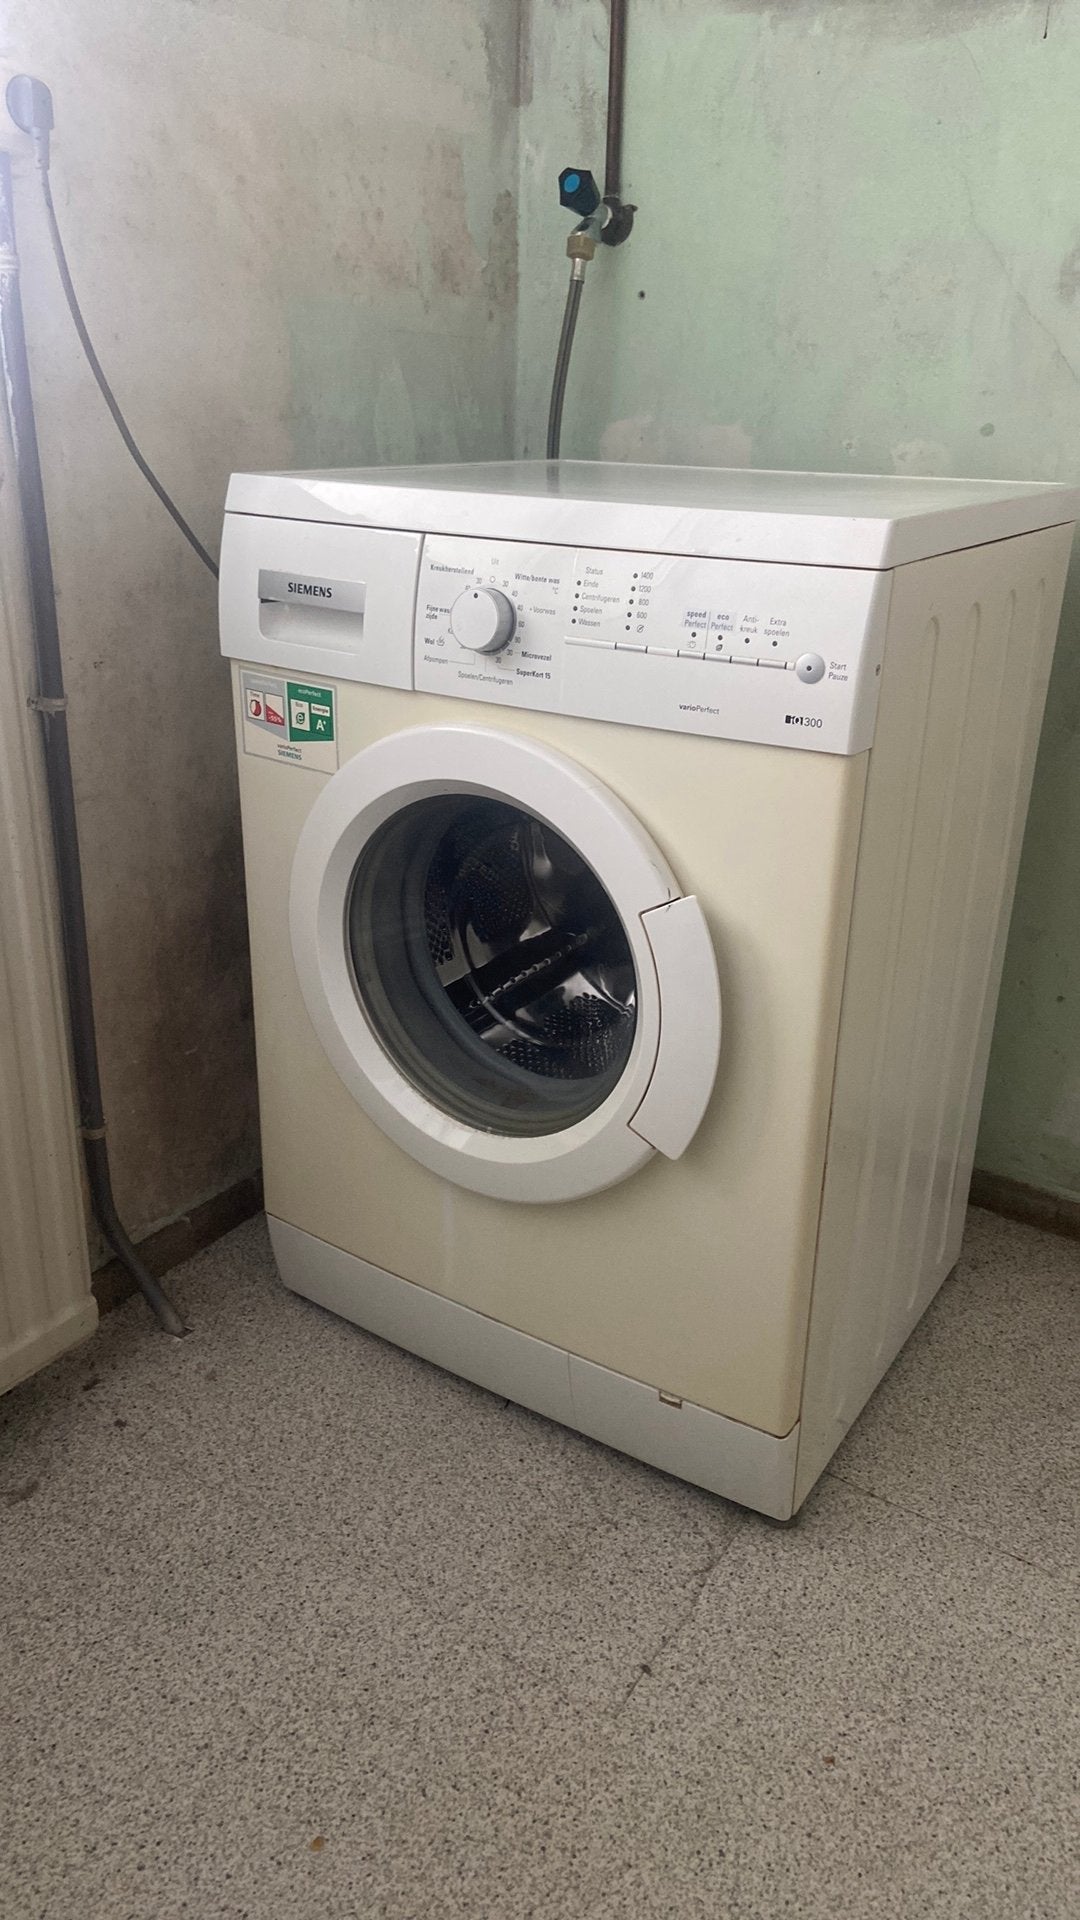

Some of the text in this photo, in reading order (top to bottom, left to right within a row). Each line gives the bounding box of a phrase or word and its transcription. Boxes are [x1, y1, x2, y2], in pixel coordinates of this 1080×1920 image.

[585, 566, 604, 576] Status
[641, 572, 654, 580] 1400
[584, 580, 598, 588] Einde
[288, 582, 332, 598] SIEMENS
[639, 585, 652, 593] 1200
[582, 592, 620, 604] Centrifugeren
[638, 598, 650, 606] 800
[580, 606, 602, 615] Spoelen
[686, 610, 707, 618] speed
[636, 612, 648, 620] 600
[743, 615, 760, 623] Anti-
[578, 618, 600, 628] Wassen
[684, 620, 706, 628] Perfect
[710, 622, 734, 631] Perfect
[770, 618, 786, 626] Extra
[740, 626, 758, 634] kreuk
[764, 628, 790, 638] spoelen
[522, 651, 552, 661] Microvezel
[830, 662, 847, 671] Start
[458, 670, 514, 684] Spoelen/Centrifugeren
[516, 668, 544, 678] SuperKort
[828, 672, 848, 682] Pauze
[298, 688, 322, 698] ecoPerfect
[679, 703, 720, 714] varioPerfect
[278, 750, 302, 760] SIEMENS
